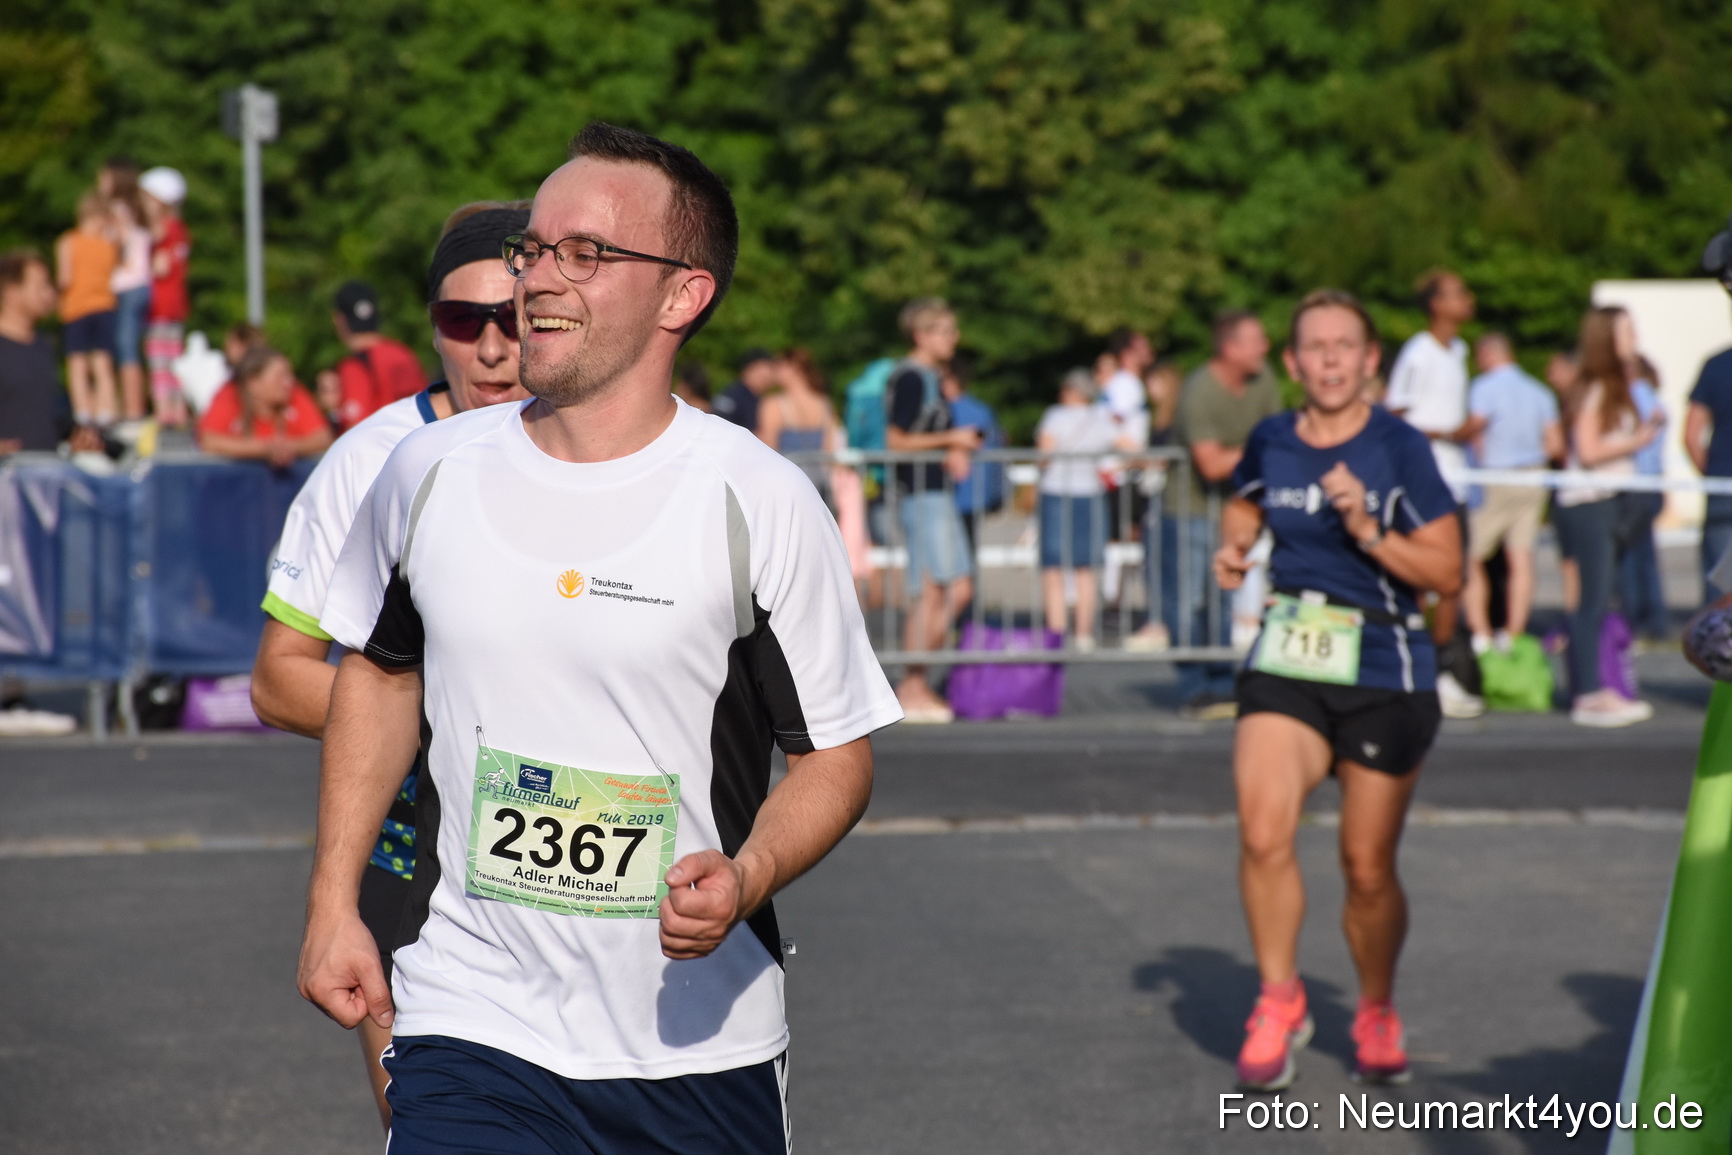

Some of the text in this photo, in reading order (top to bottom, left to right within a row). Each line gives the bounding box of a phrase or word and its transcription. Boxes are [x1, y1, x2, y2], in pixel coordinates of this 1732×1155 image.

[589, 588, 660, 605] Steuerberatungsgesellschaft
[591, 577, 633, 591] Treukontax
[1281, 624, 1333, 660] 718
[502, 796, 535, 808] neumarkt
[503, 782, 582, 810] firmenlauf
[627, 814, 664, 825] 2019
[489, 807, 647, 877] 2367
[475, 869, 517, 887] Treukontax
[518, 882, 636, 902] Steuerberatungsgesellschaft
[512, 866, 618, 892] Adler Michael
